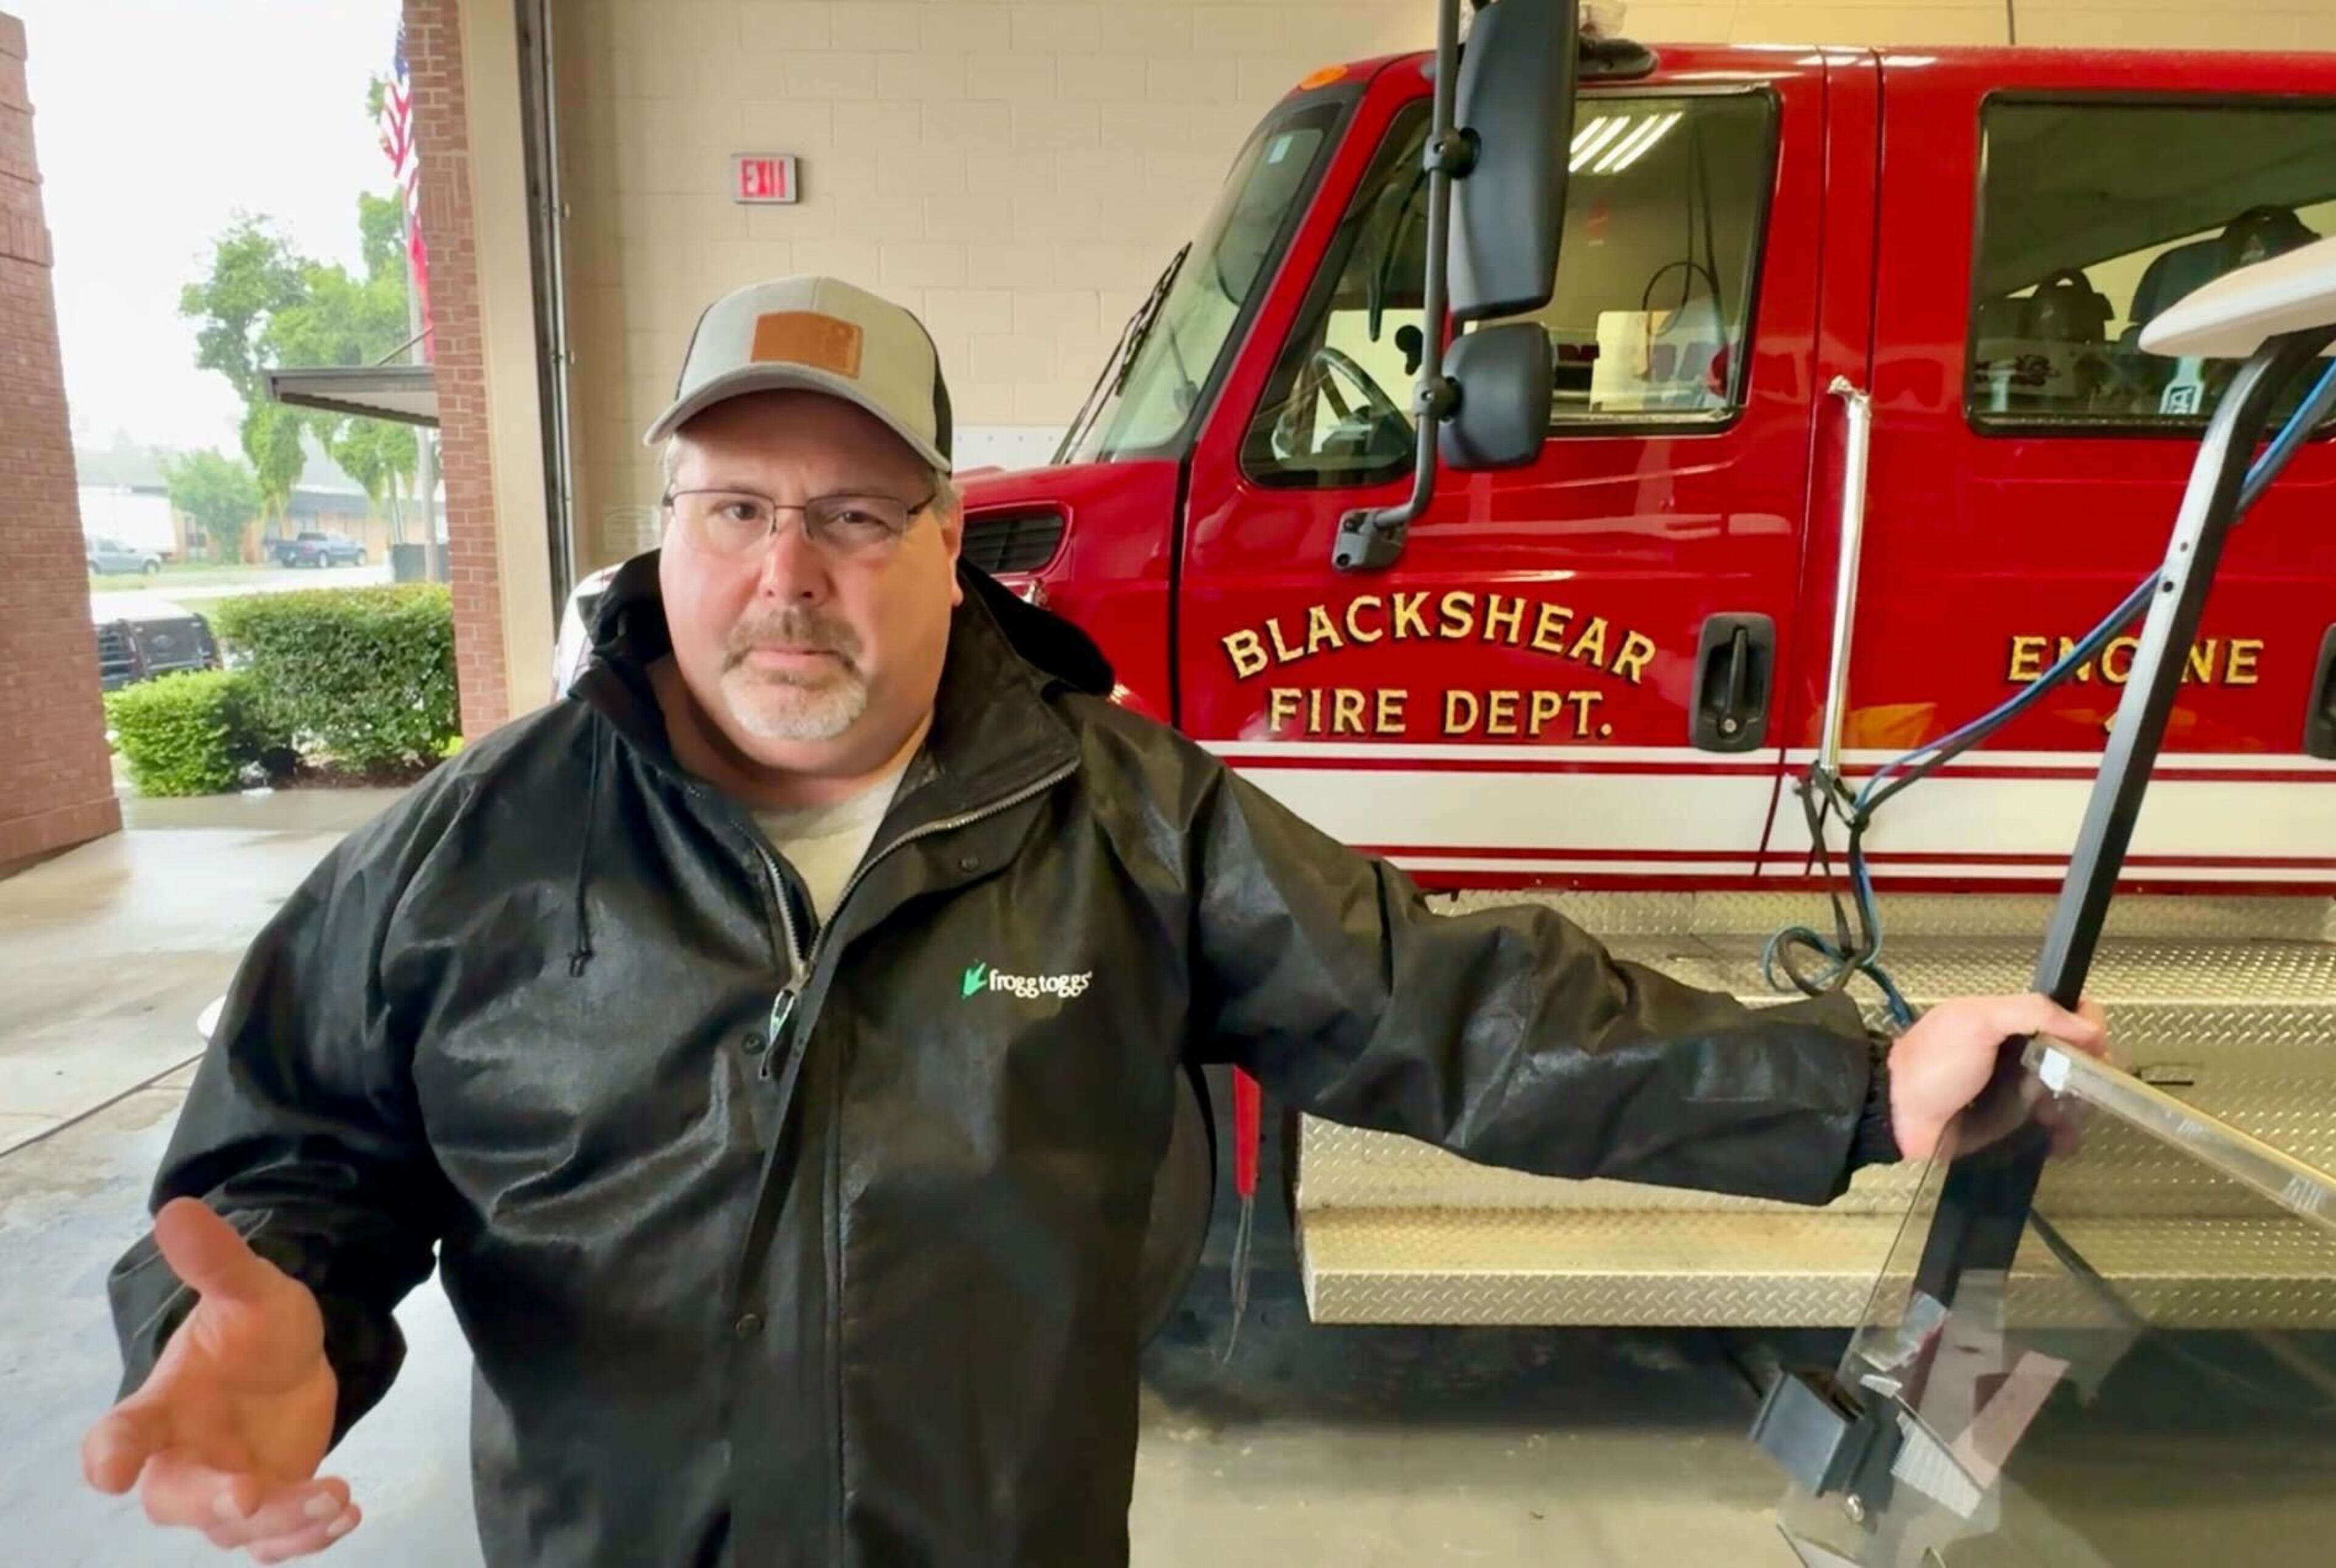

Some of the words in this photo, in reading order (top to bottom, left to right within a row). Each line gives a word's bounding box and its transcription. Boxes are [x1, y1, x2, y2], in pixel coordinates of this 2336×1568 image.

[1222, 591, 1657, 684] BLACKSHEAR
[2007, 636, 2264, 684] ENGNE
[1270, 688, 1408, 733] FIRE
[1444, 690, 1613, 736] DEPT.
